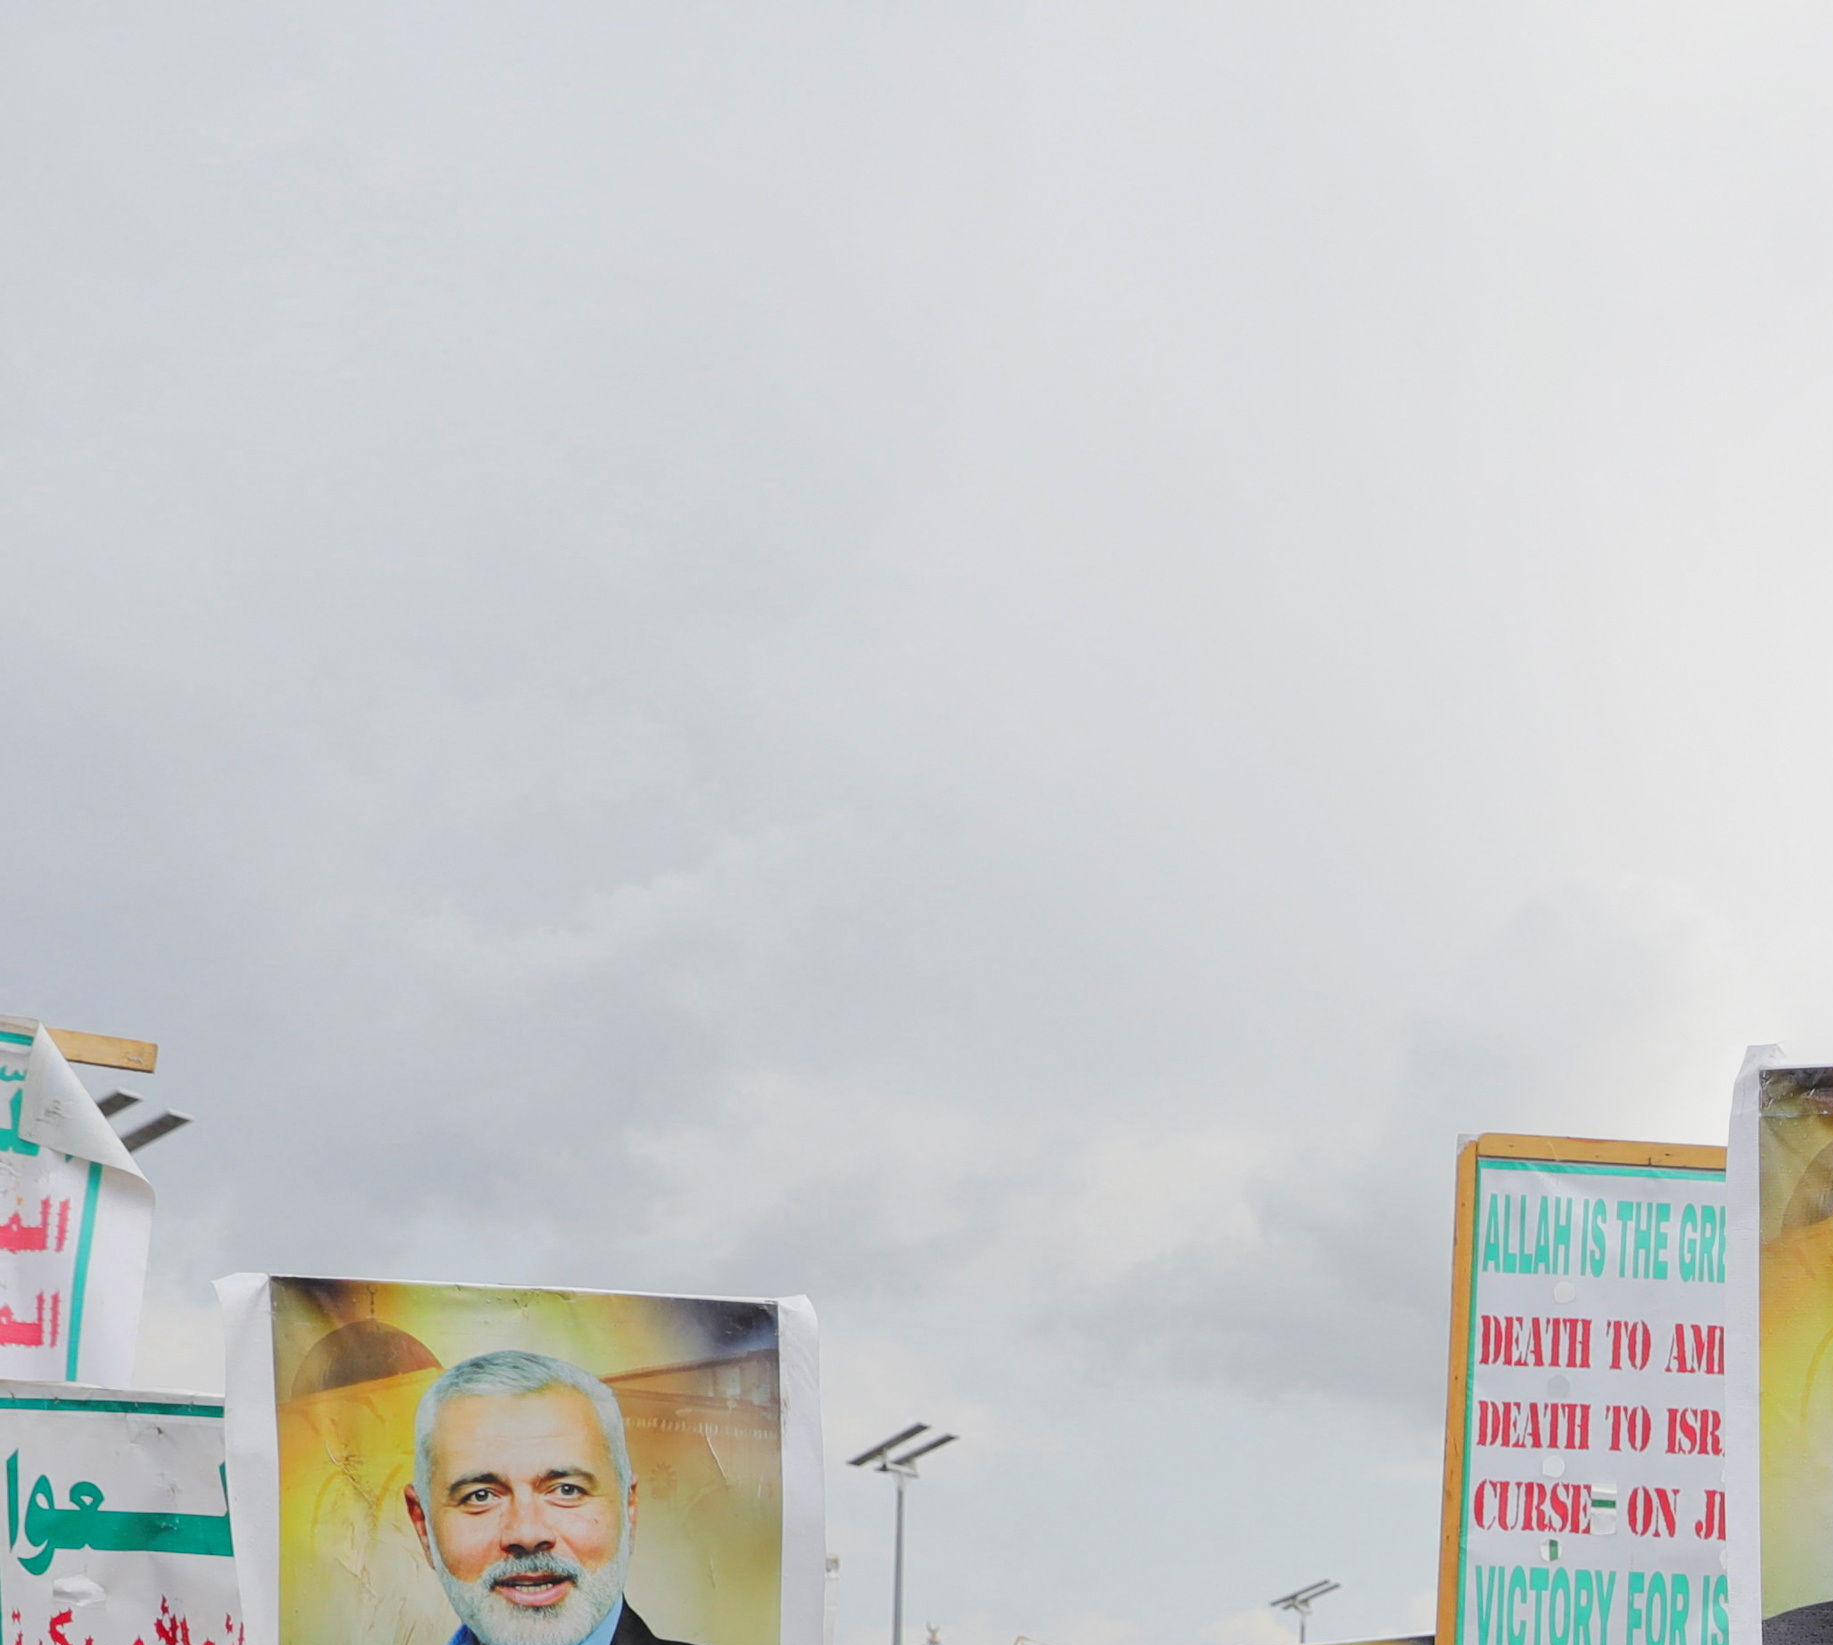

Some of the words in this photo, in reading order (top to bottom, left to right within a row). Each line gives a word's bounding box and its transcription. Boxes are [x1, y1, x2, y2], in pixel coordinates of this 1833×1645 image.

[1482, 1193, 1571, 1275] ALLAH
[1580, 1198, 1606, 1277] IS
[1617, 1201, 1669, 1281] THE
[1480, 1315, 1592, 1368] DEATH
[1606, 1320, 1652, 1371] TO
[1476, 1400, 1591, 1450] DEATH
[1605, 1403, 1652, 1452] TO
[1474, 1480, 1592, 1535] CURSE
[1627, 1487, 1680, 1539] ON
